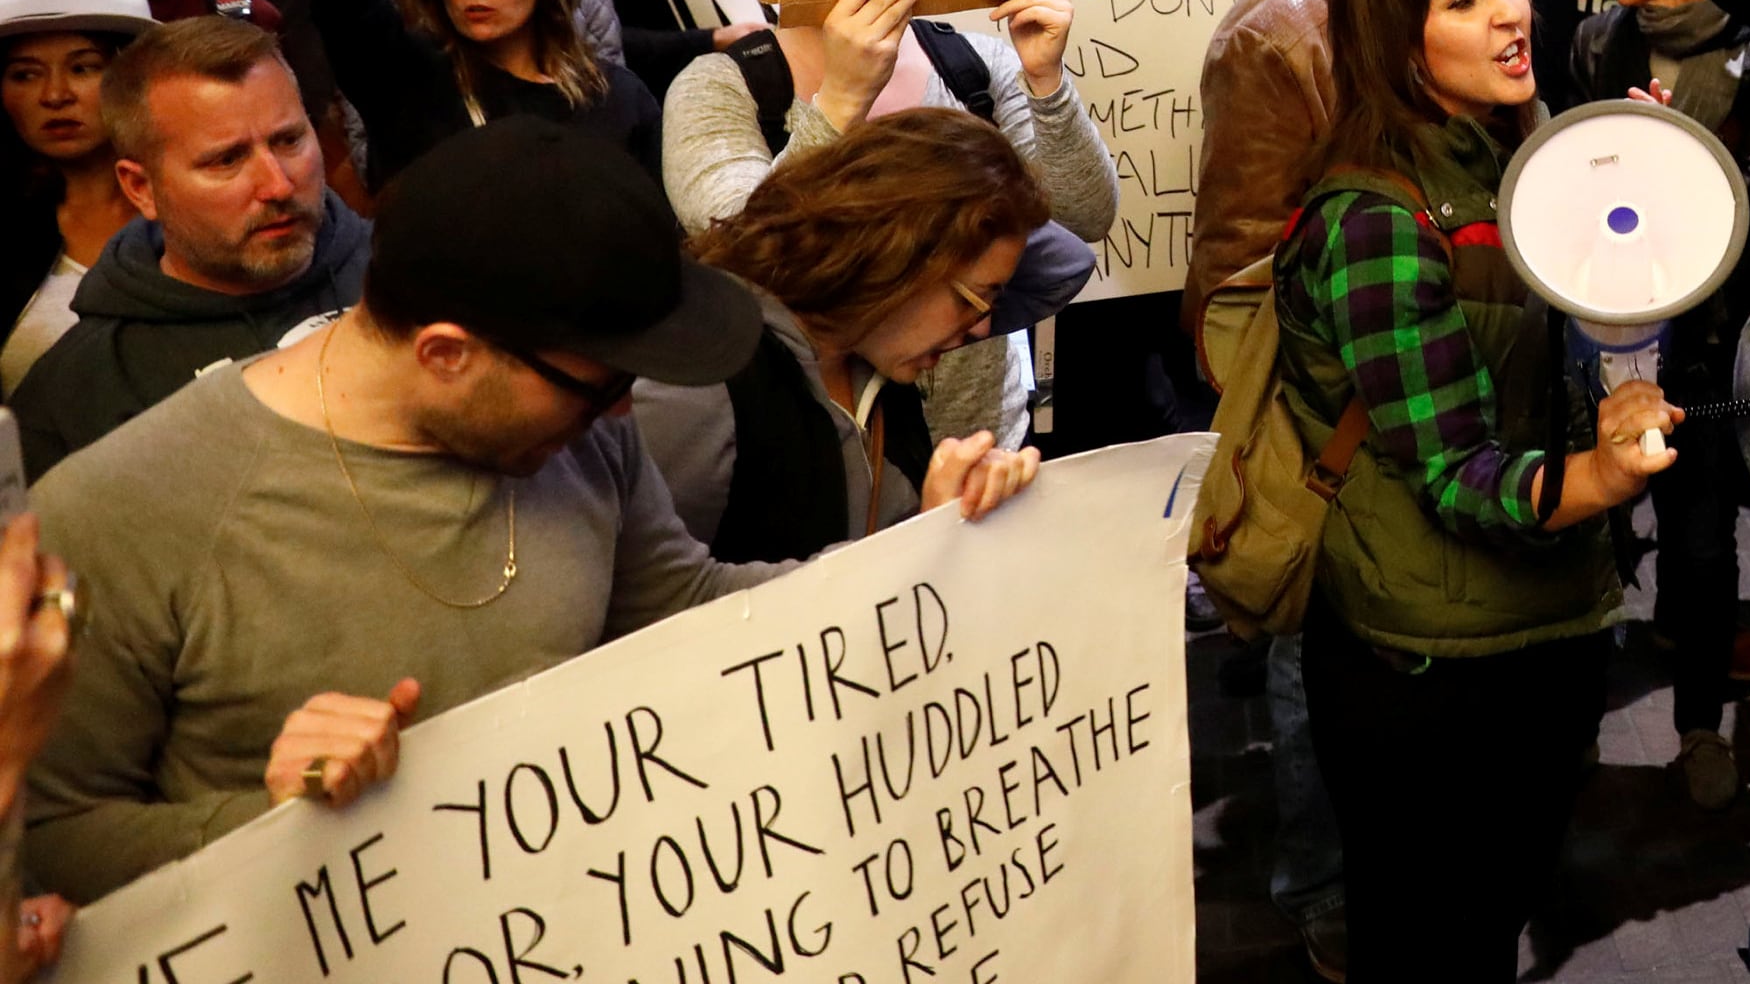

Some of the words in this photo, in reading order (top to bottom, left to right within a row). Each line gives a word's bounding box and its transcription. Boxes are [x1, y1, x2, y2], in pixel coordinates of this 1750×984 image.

[294, 832, 407, 978] ME
[432, 706, 710, 881] YOUR
[587, 784, 827, 948] YOUR
[831, 641, 1061, 838] HUDDLED
[851, 838, 914, 917] TO
[935, 682, 1151, 873] BREATHE
[896, 822, 1065, 982] REFUSE
